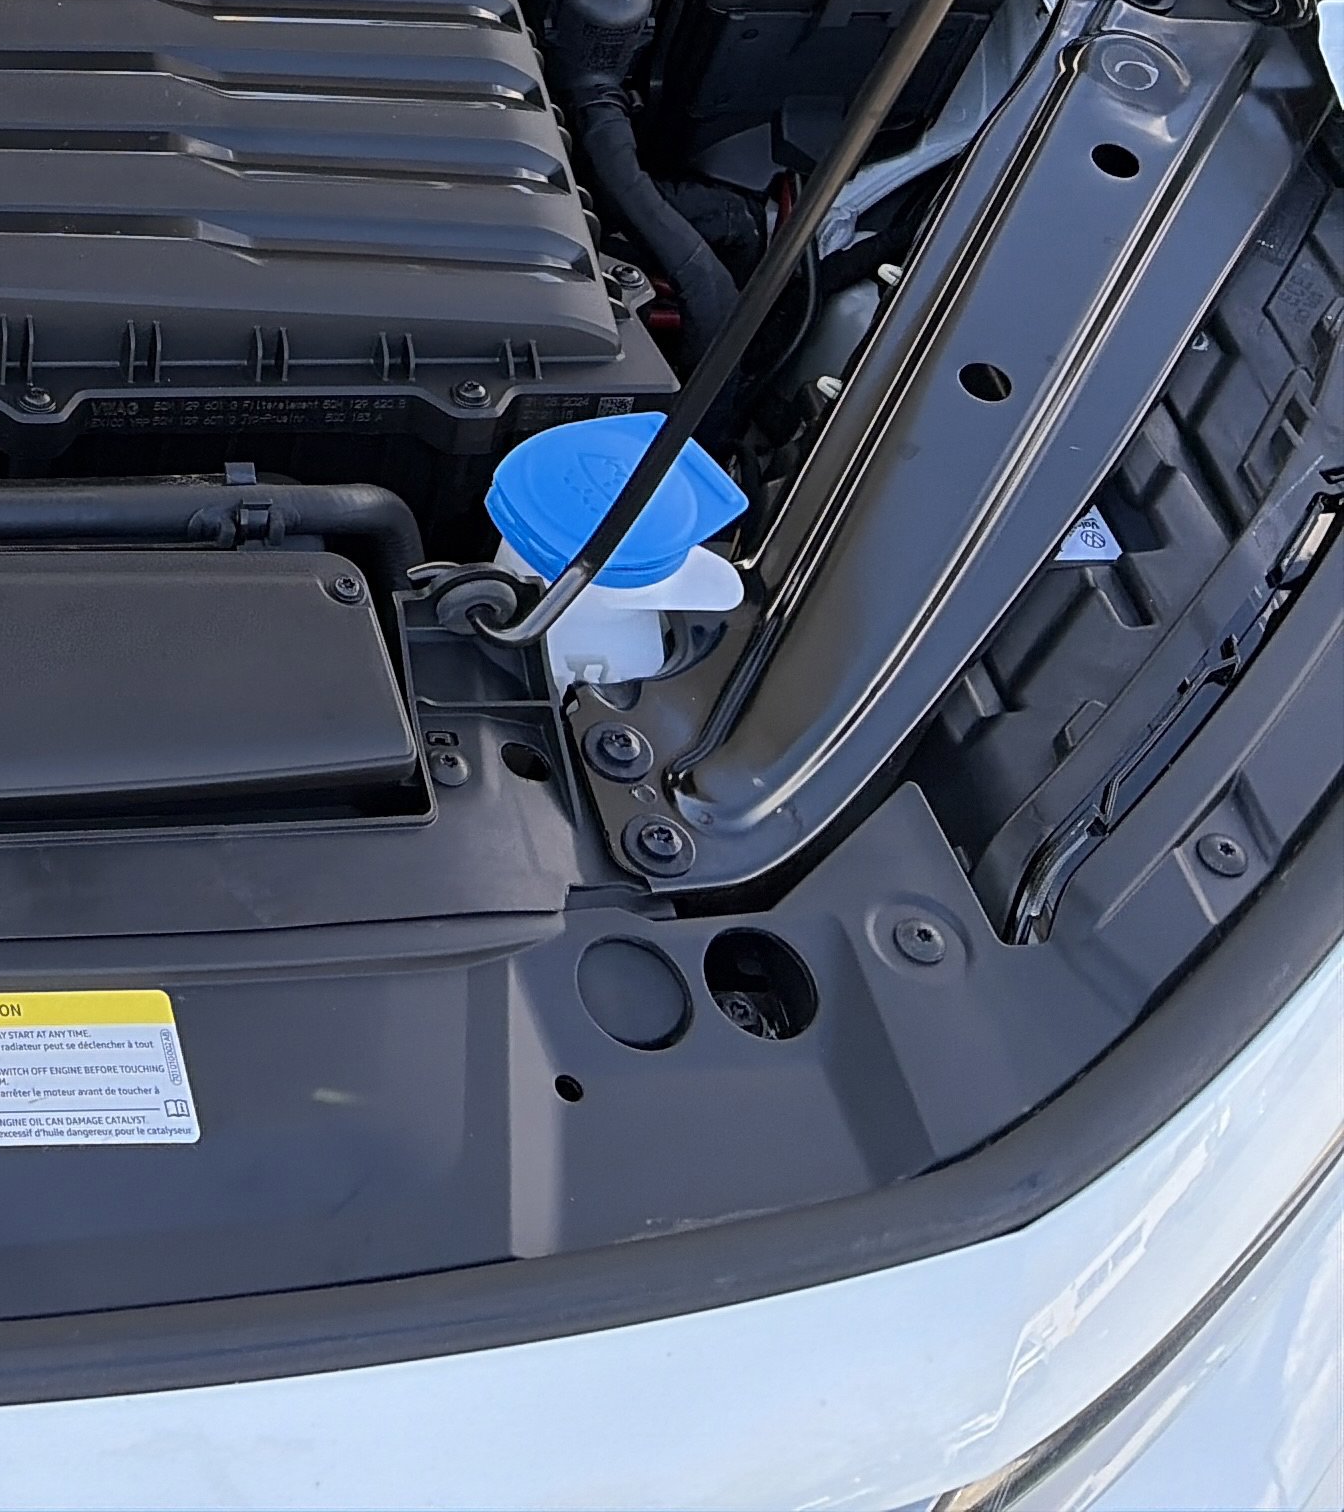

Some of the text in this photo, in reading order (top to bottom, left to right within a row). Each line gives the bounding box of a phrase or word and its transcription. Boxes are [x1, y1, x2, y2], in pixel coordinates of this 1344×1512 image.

[8, 1030, 34, 1039] START
[36, 1030, 47, 1039] AT
[49, 1030, 66, 1038] ANY
[1, 1041, 41, 1051] radiateur
[43, 1041, 64, 1052] peut
[65, 1042, 76, 1050] se
[77, 1041, 126, 1050] déclencher
[134, 1040, 154, 1048] tout
[31, 1067, 47, 1076] OFF
[50, 1066, 82, 1075] ENGINE
[84, 1065, 119, 1074] BEFORE
[120, 1064, 165, 1074] TOUCHING
[0, 1088, 31, 1098] arrêter
[32, 1088, 41, 1097] le
[43, 1088, 76, 1097] moteur
[77, 1087, 103, 1096] avant
[104, 1086, 116, 1095] de
[118, 1086, 152, 1095] toucher
[29, 1117, 44, 1127] OIL
[45, 1116, 63, 1126] CAN
[65, 1116, 103, 1126] DAMAGE
[34, 1127, 65, 1138] d'huile
[66, 1127, 113, 1138] dangereux
[115, 1127, 135, 1138] pour
[136, 1126, 144, 1135] le
